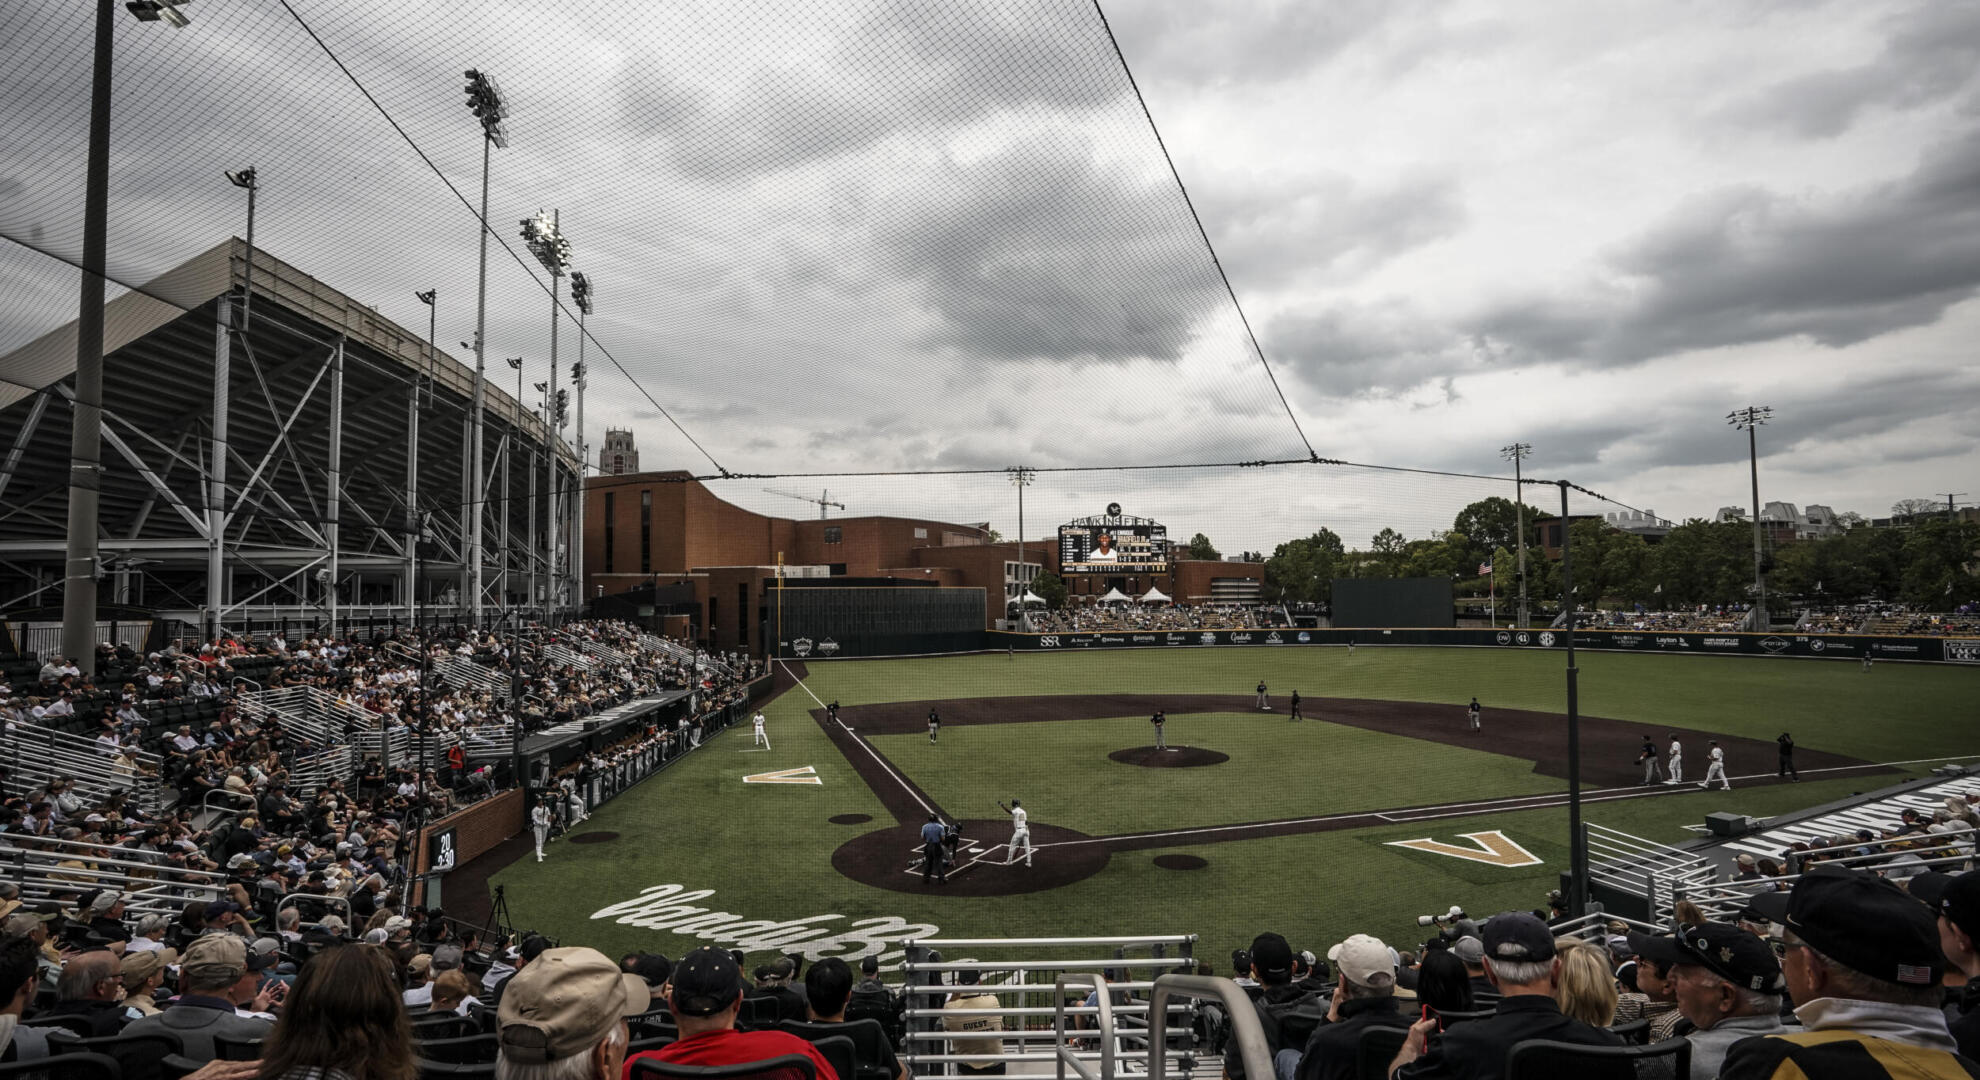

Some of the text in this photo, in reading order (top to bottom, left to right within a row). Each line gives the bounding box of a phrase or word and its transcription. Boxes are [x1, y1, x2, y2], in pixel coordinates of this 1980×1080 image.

[1072, 518, 1154, 526] HAWKINS FIELD
[1040, 636, 1061, 647] SSR
[1518, 634, 1527, 642] 41
[1540, 633, 1554, 646] SEC
[742, 765, 824, 785] V
[441, 832, 451, 854] 20
[1382, 830, 1545, 868] V
[963, 1019, 988, 1031] GUEST
